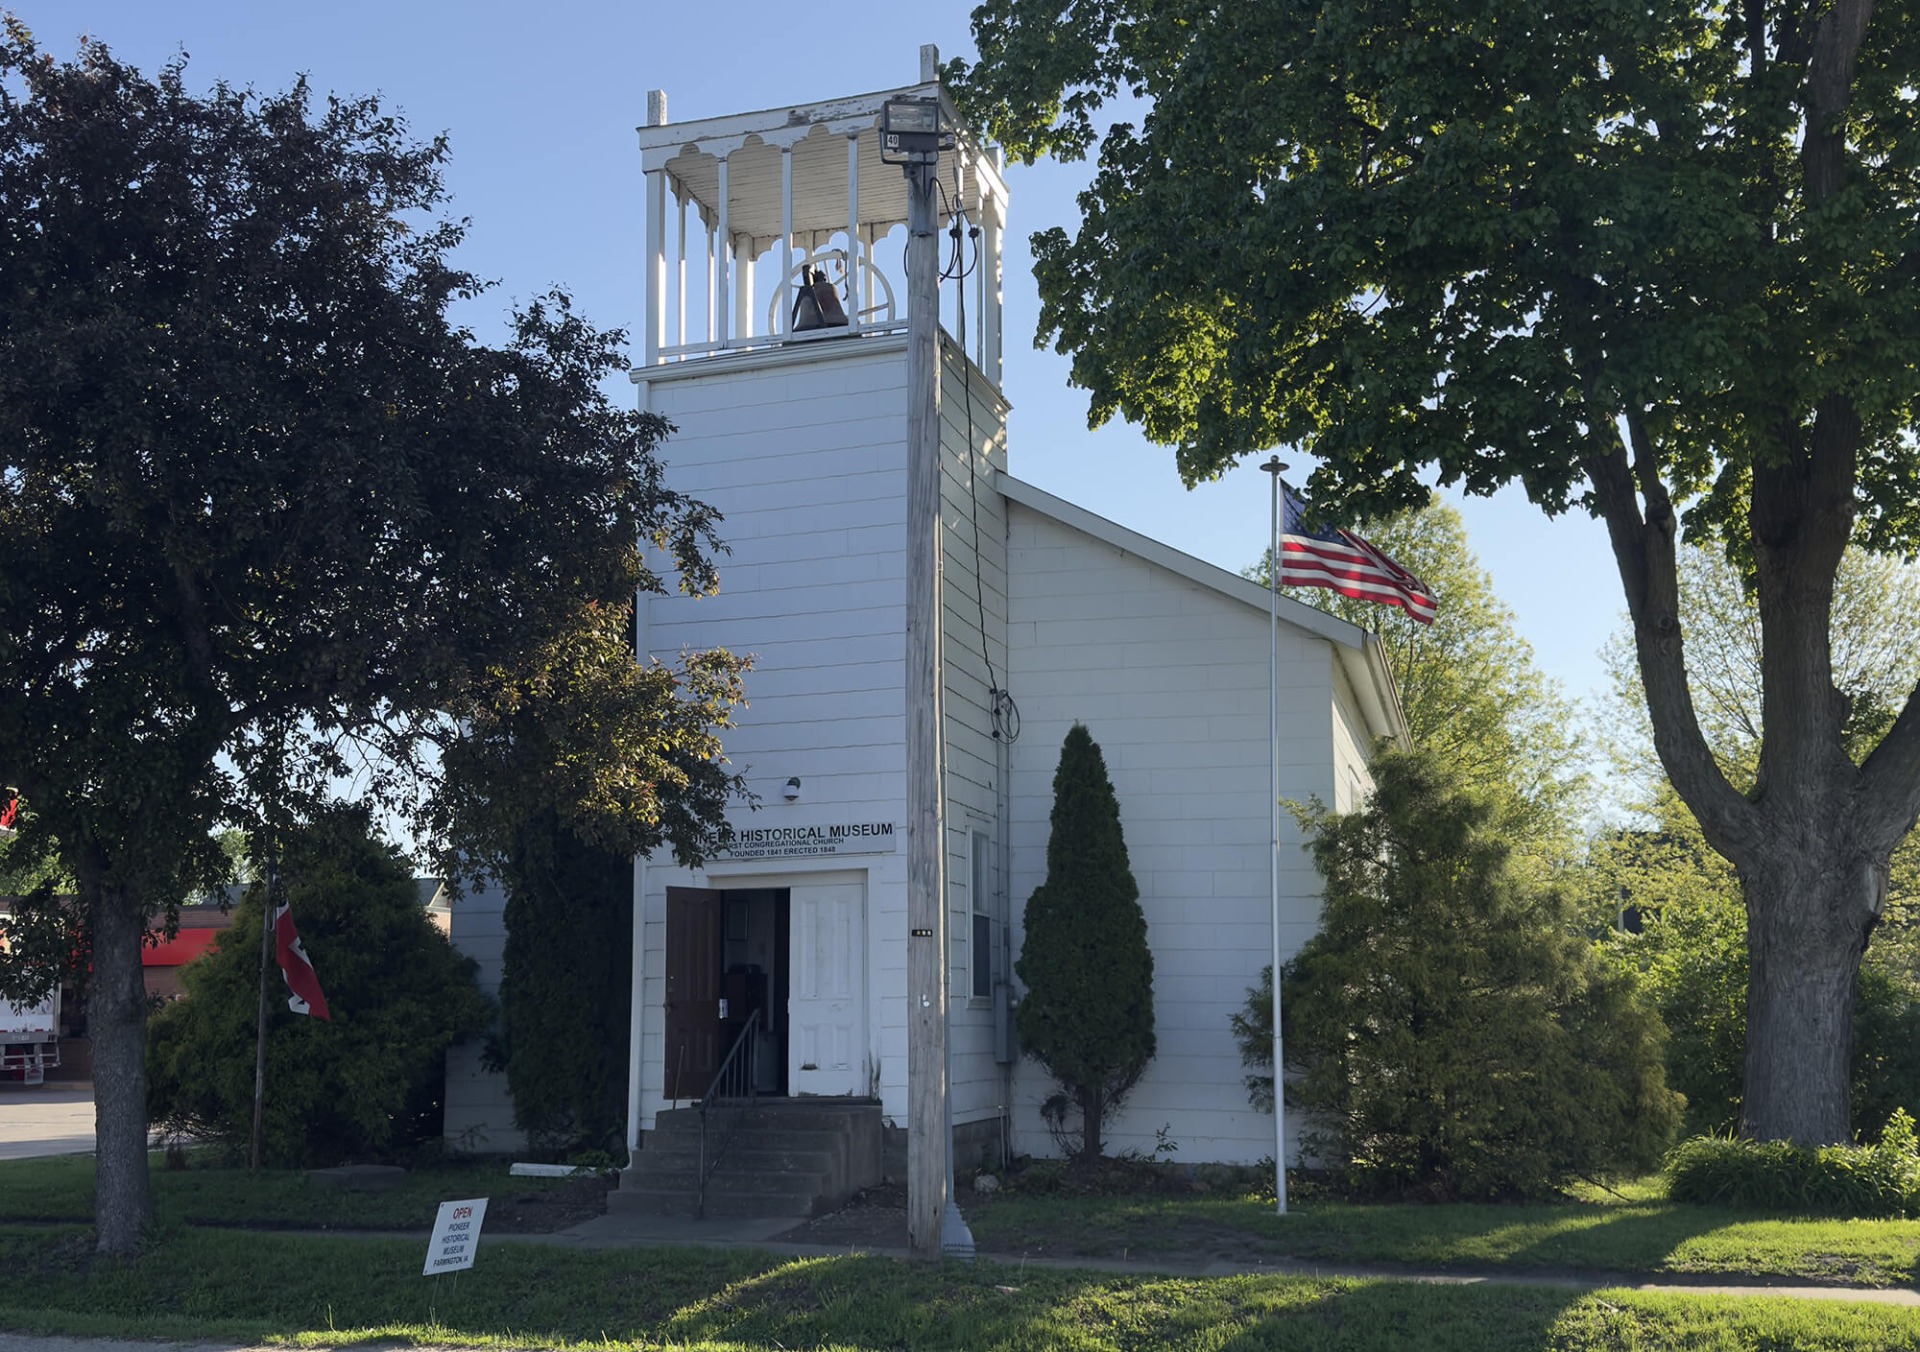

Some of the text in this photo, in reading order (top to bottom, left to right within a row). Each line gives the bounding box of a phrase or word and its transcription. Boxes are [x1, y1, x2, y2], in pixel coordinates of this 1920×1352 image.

[741, 827, 825, 842] HISTORICAL
[829, 823, 893, 838] MUSEUM
[744, 839, 811, 849] CONGREGATIONAL
[730, 848, 765, 858] FOUNDED
[767, 848, 782, 856] 1841
[784, 846, 818, 855] ERECTED
[453, 1207, 473, 1219] OPEN
[448, 1222, 470, 1232] PIONEER
[442, 1234, 470, 1244] HISTORICAL
[443, 1245, 464, 1255] MUSEUM
[433, 1257, 462, 1267] FARMINGTON
